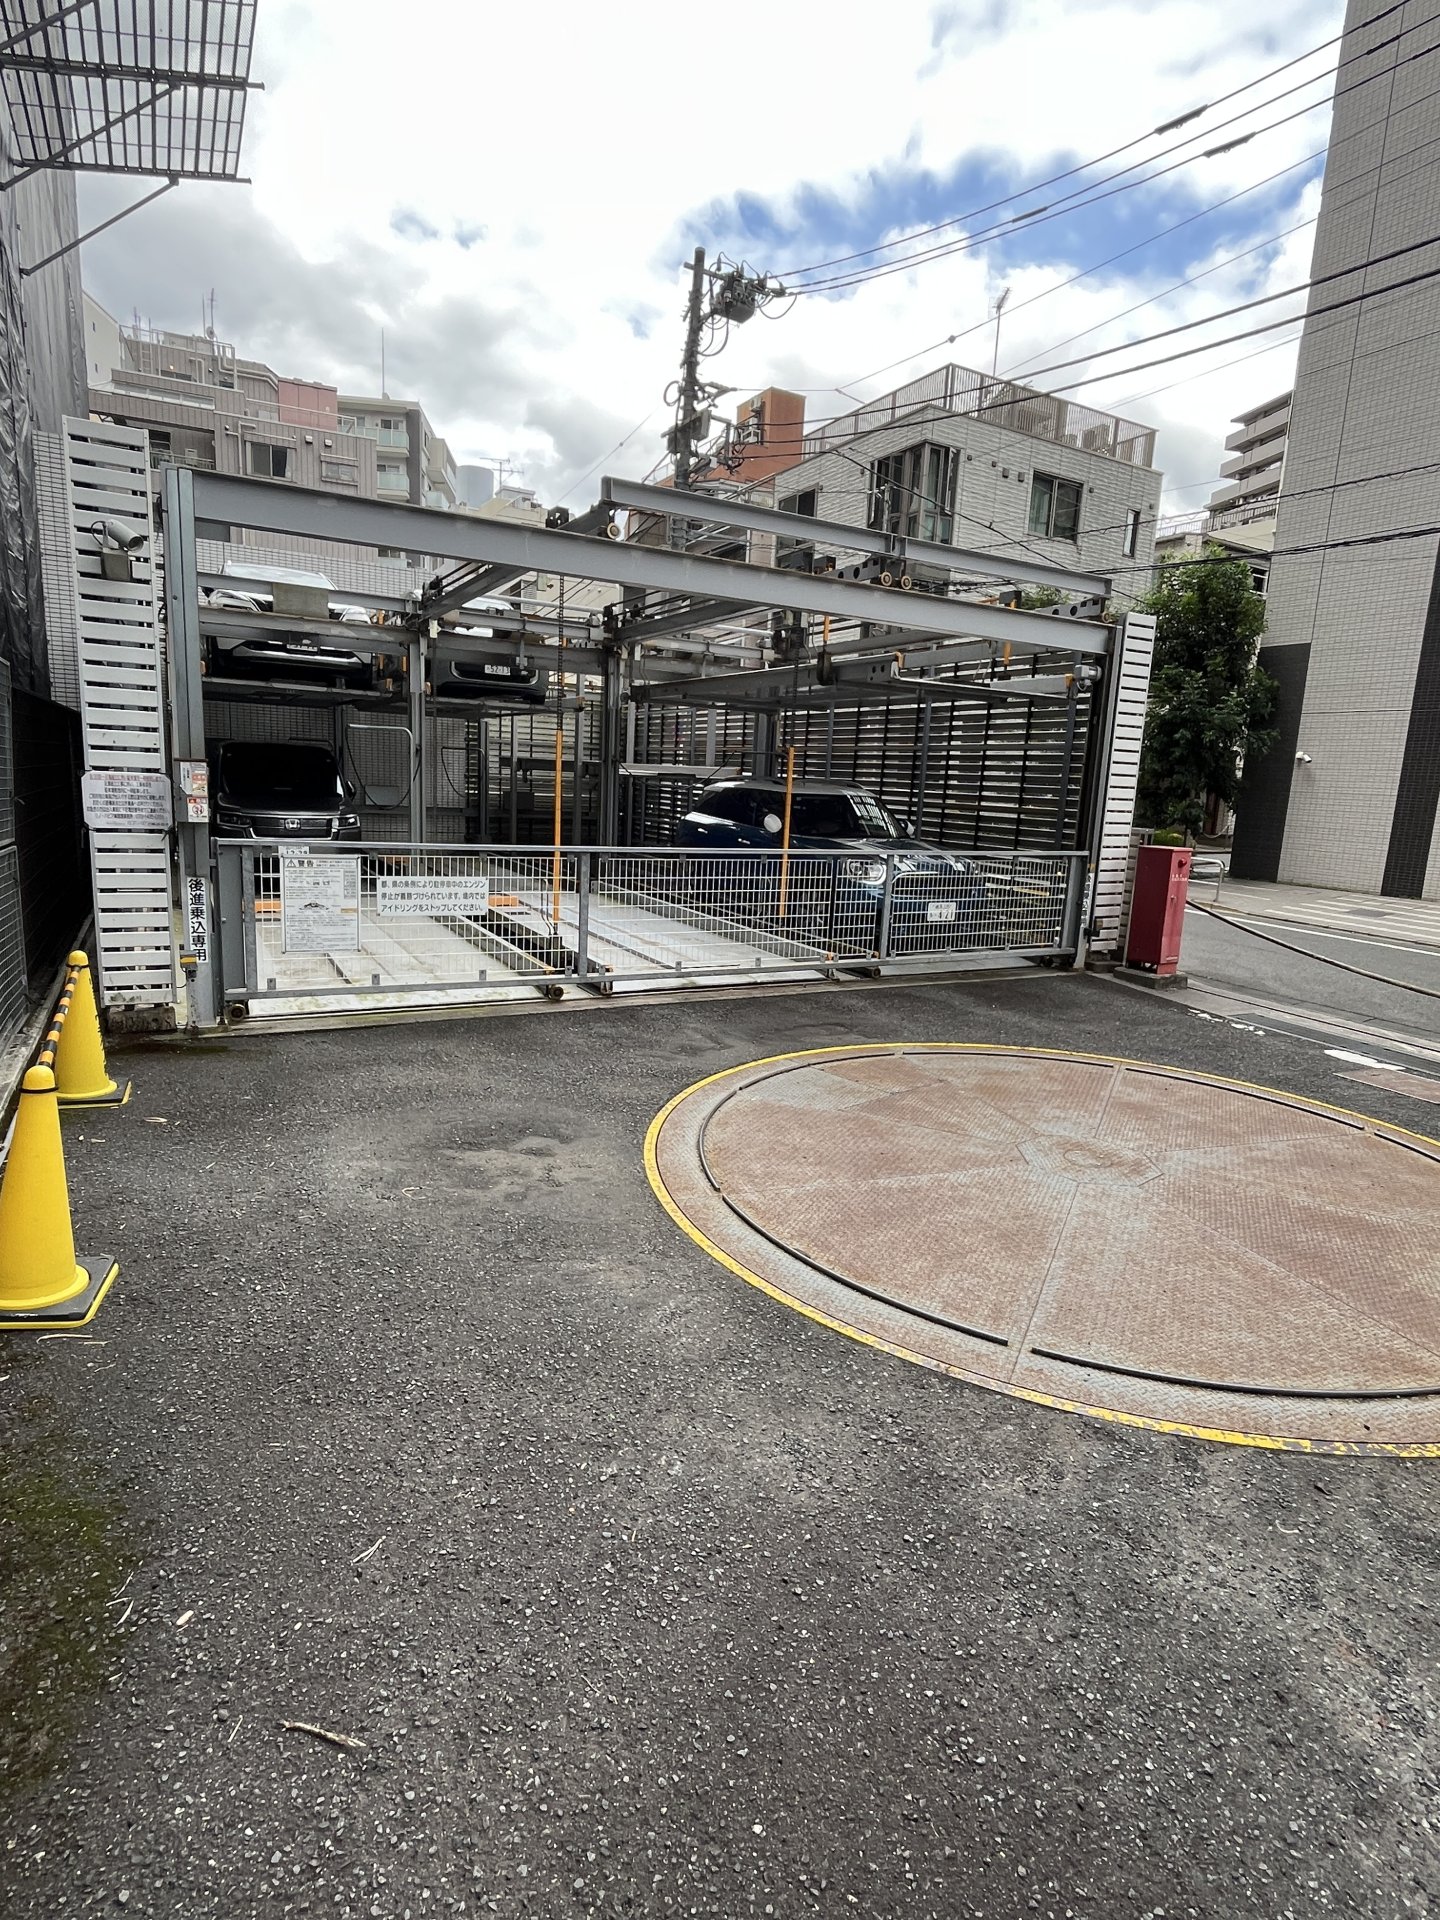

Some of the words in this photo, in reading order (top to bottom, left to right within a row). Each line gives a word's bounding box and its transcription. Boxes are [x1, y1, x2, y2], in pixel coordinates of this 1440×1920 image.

[188, 878, 207, 962] 後進乗込専用
